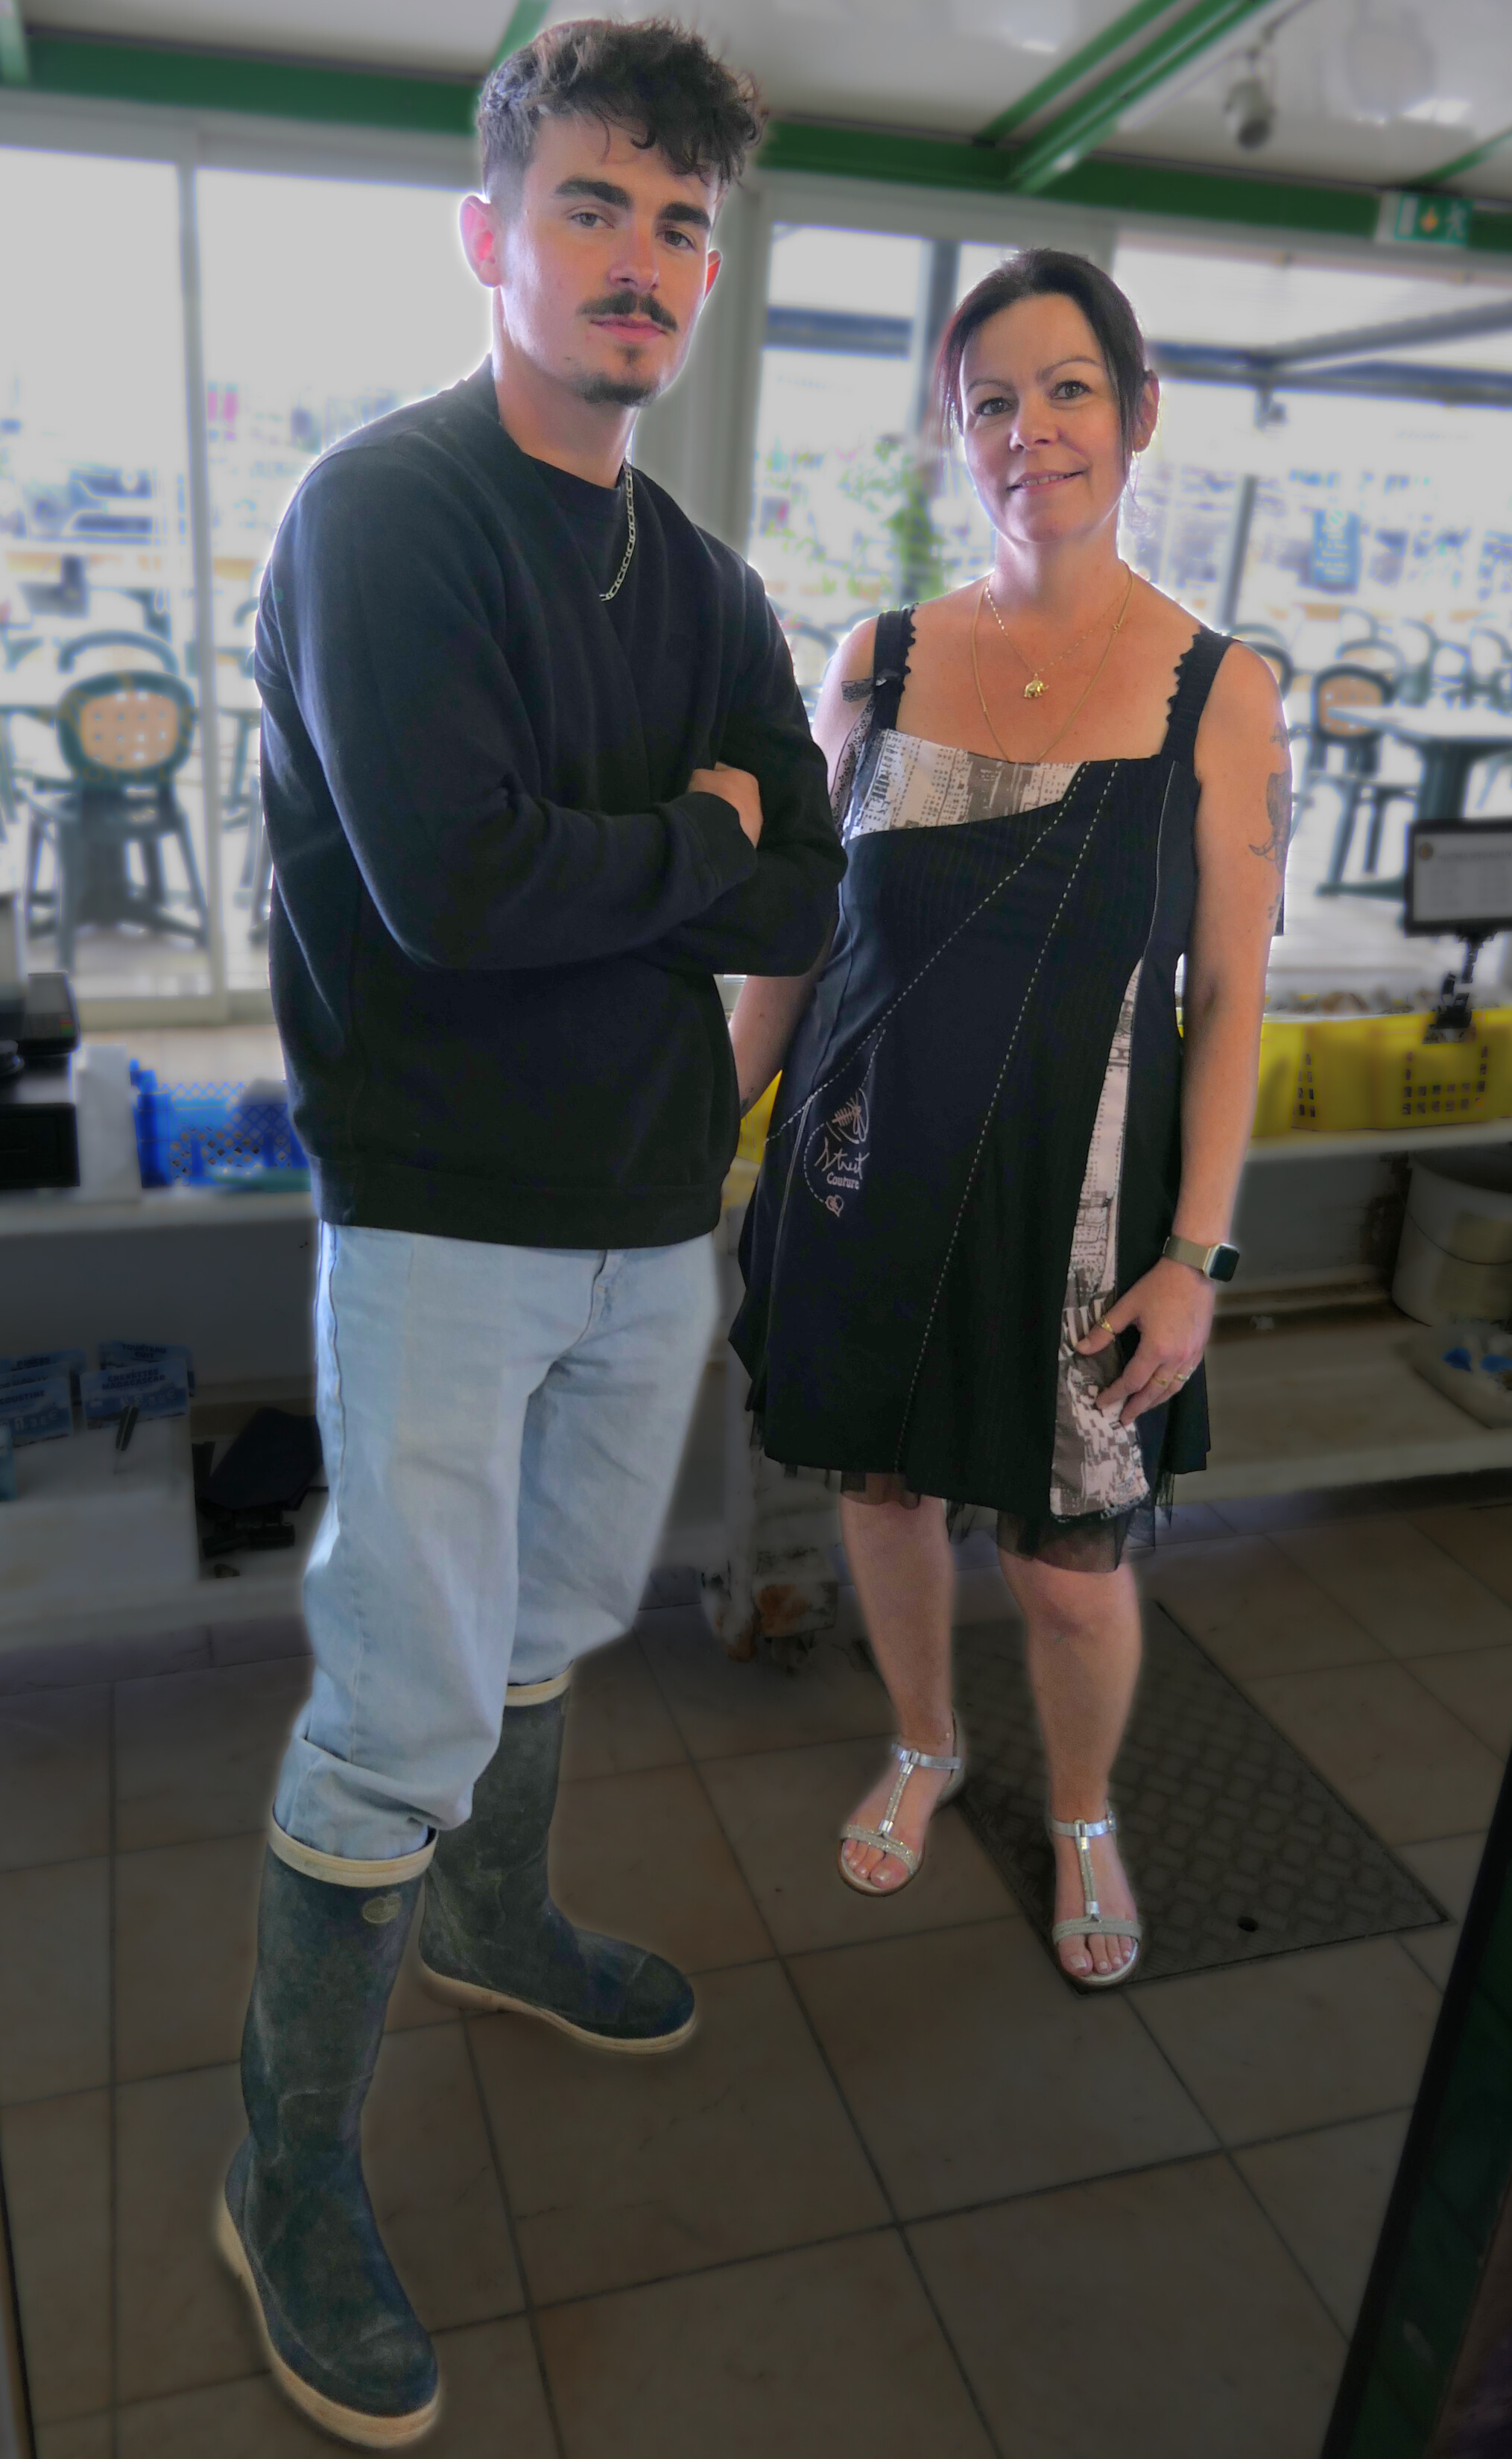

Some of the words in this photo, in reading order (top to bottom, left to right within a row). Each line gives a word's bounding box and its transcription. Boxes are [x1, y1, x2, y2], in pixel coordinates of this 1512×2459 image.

[826, 1171, 860, 1190] Couture
[134, 1351, 154, 1359] CUIT
[101, 1375, 165, 1390] MADAGASCAR
